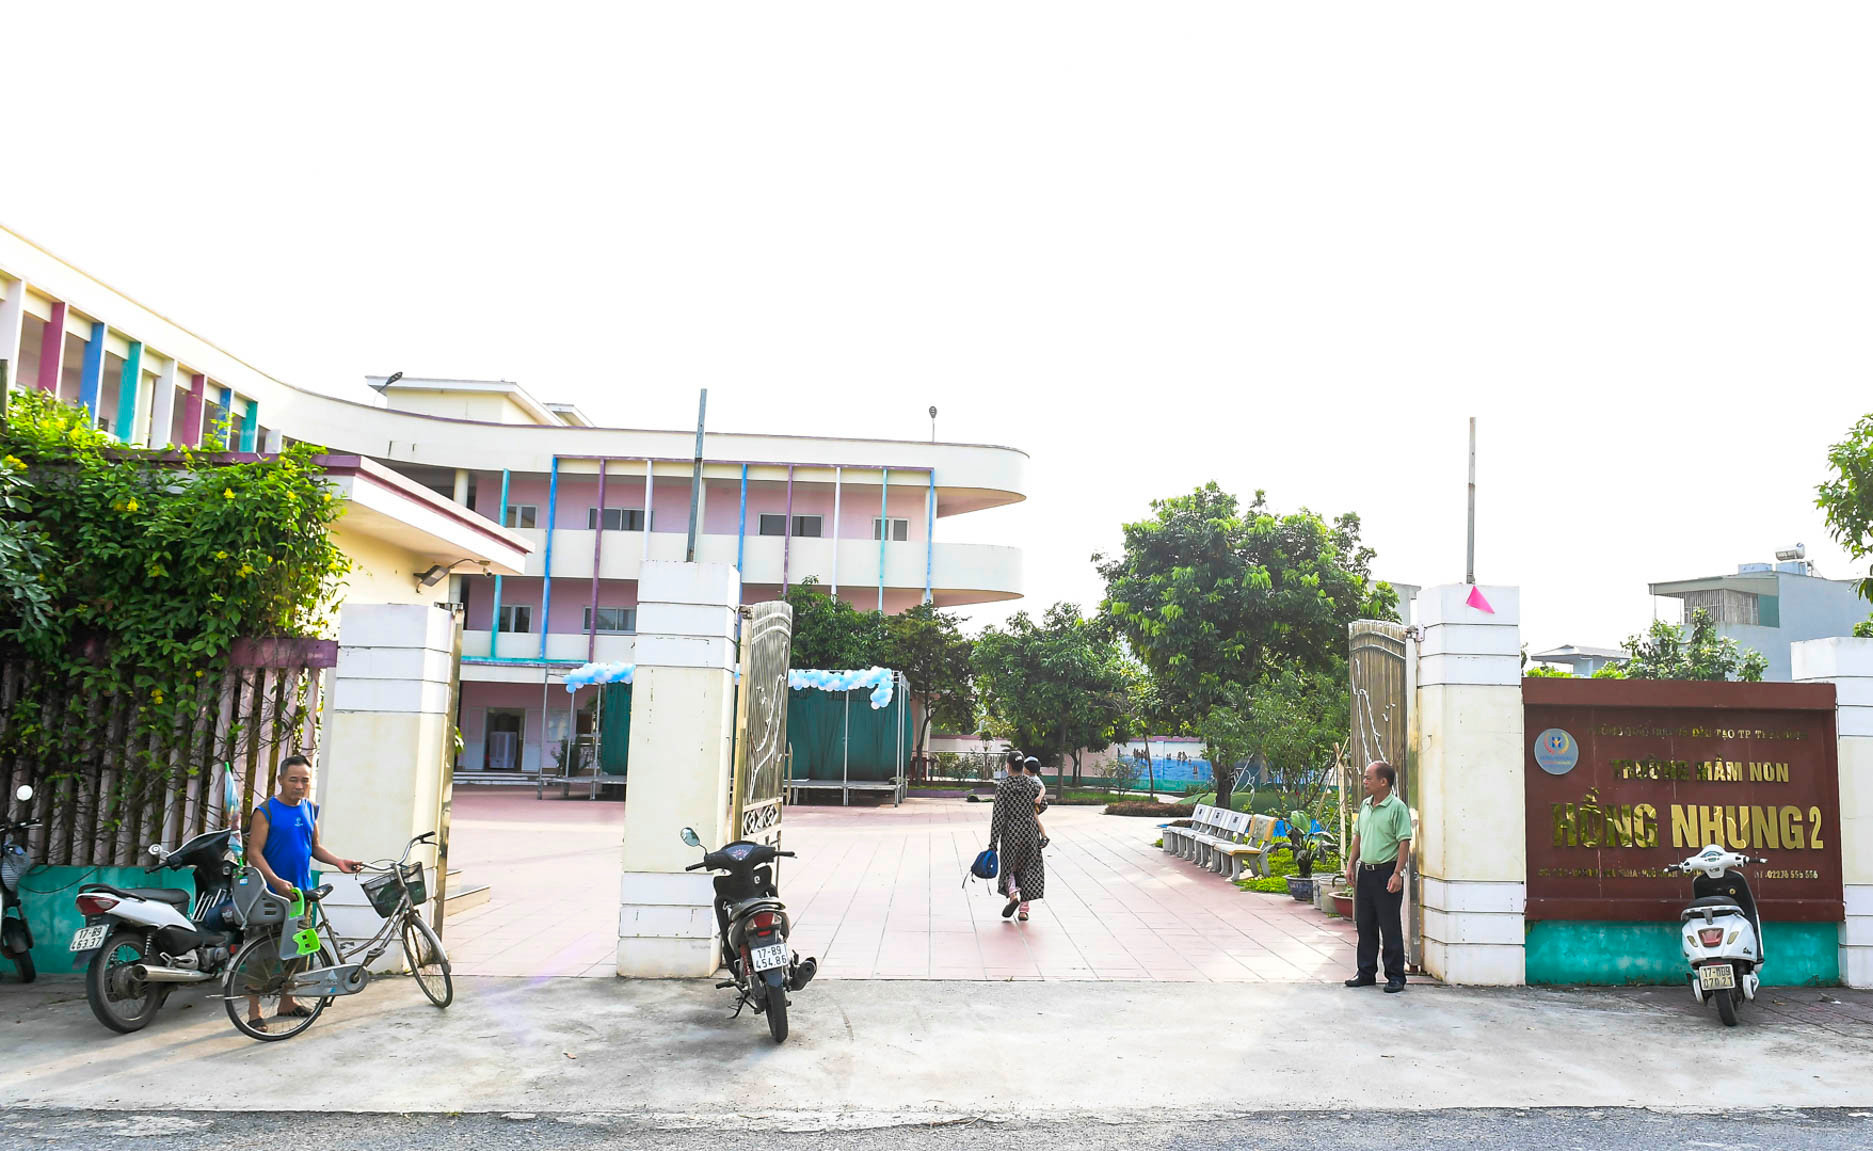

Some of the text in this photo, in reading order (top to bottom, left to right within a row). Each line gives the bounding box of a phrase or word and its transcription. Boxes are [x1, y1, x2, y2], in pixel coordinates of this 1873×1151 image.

[1738, 729, 1751, 739] TP
[1749, 762, 1790, 783] NON
[1551, 785, 1659, 849] HỒNG
[757, 945, 782, 958] 17-B9
[756, 954, 787, 969] 454.86
